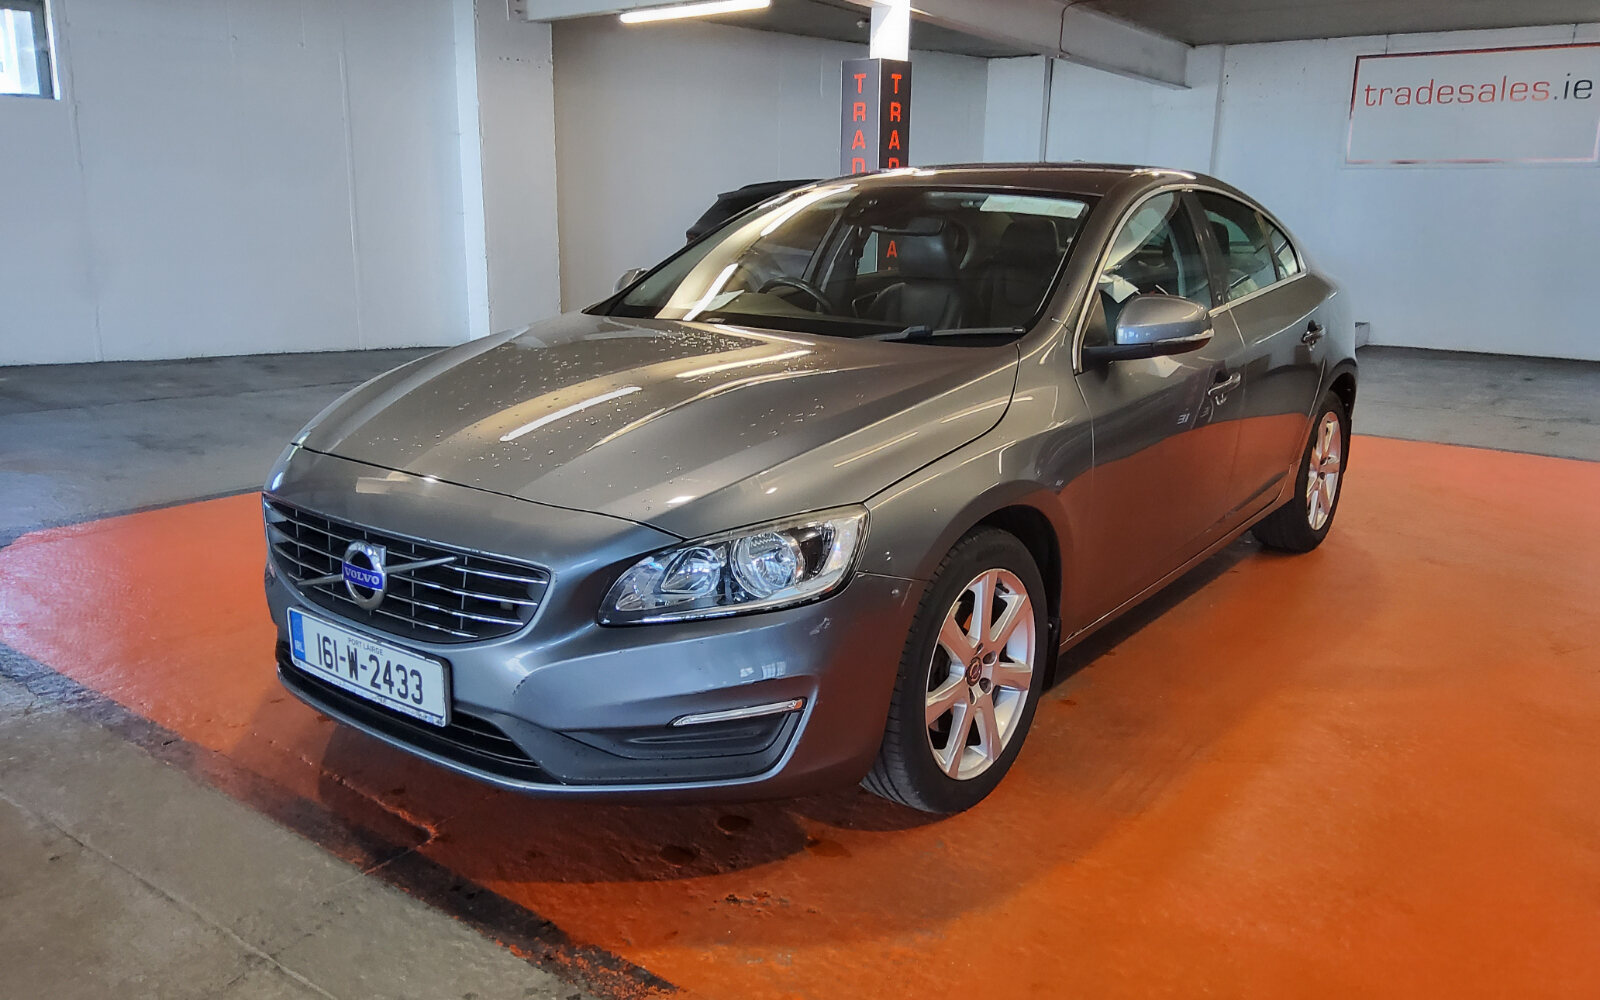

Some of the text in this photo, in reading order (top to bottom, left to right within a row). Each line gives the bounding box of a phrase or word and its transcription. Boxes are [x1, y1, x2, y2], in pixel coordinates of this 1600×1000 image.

[1364, 72, 1593, 107] tradesales.ie
[344, 566, 380, 585] VOLVO
[316, 633, 424, 705] 161-W-2433
